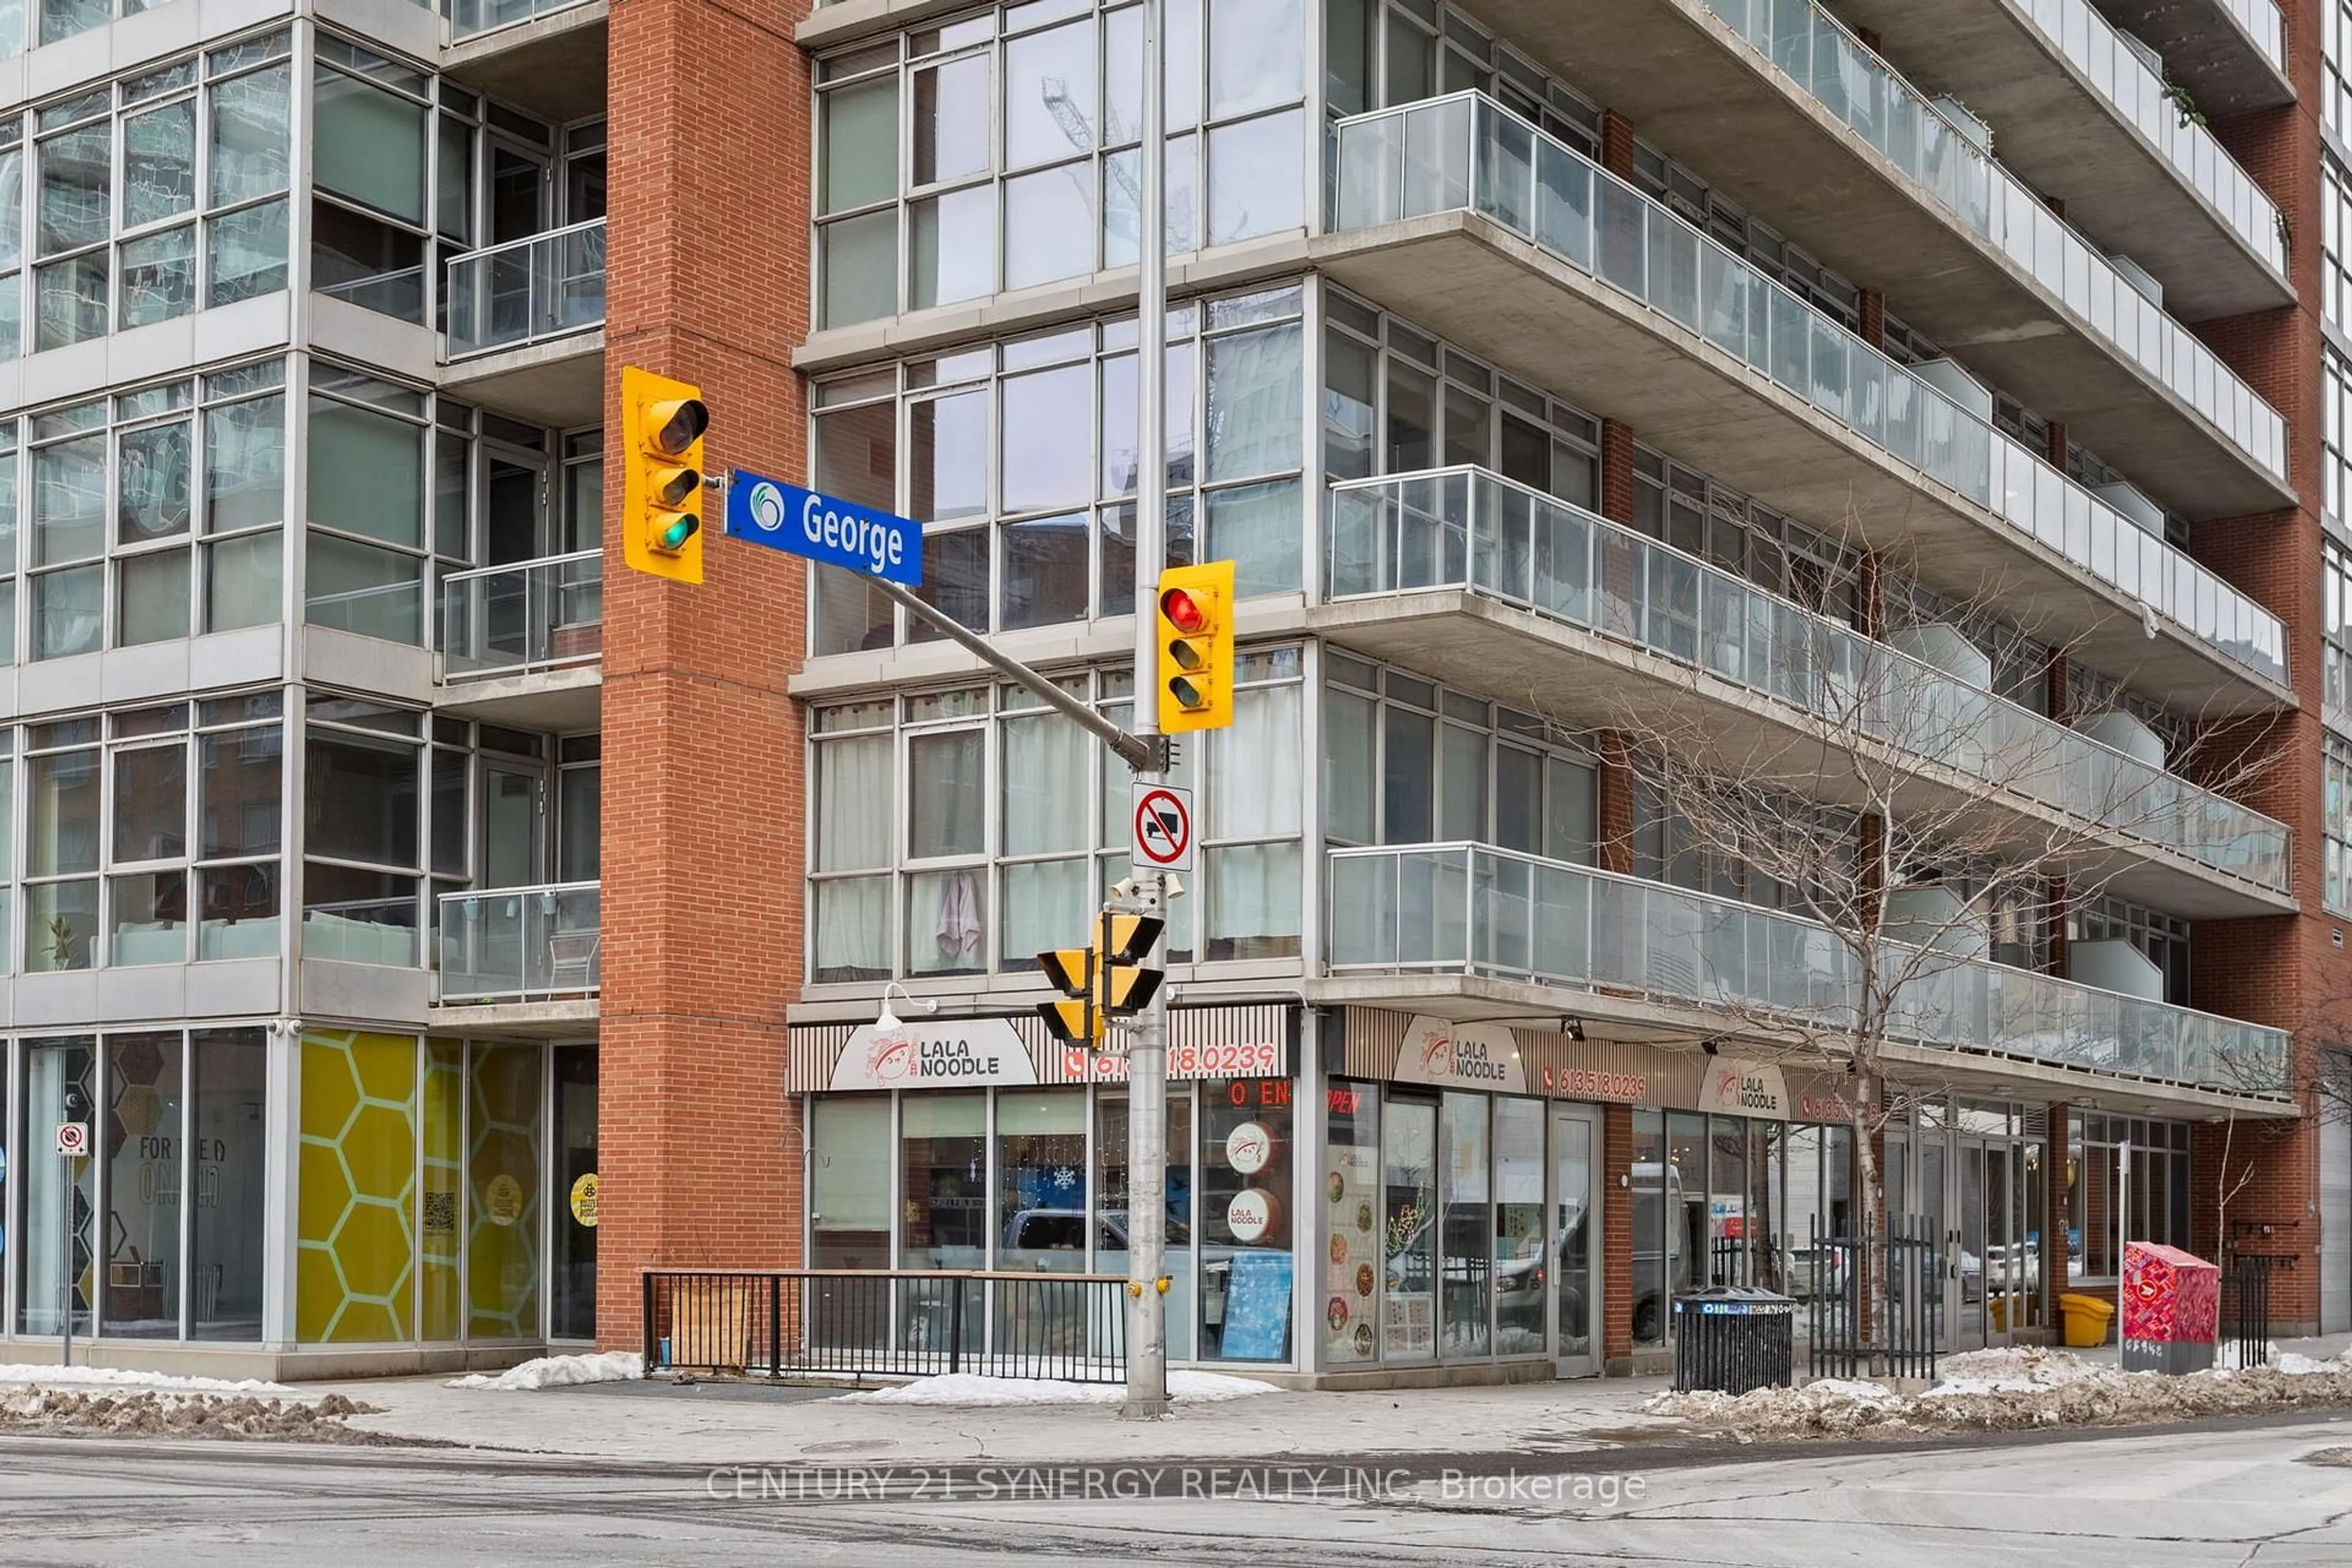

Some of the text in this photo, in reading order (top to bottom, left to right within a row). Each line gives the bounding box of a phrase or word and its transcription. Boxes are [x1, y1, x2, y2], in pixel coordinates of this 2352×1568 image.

[803, 494, 902, 573] George
[921, 1039, 969, 1058] LALA
[1457, 1041, 1487, 1060] LALA
[920, 1058, 999, 1076] NOODLE
[1457, 1059, 1506, 1080] NOODLE
[1741, 1076, 1763, 1093] LALA
[1741, 1093, 1776, 1109] NOODLE
[140, 1137, 171, 1159] FOR
